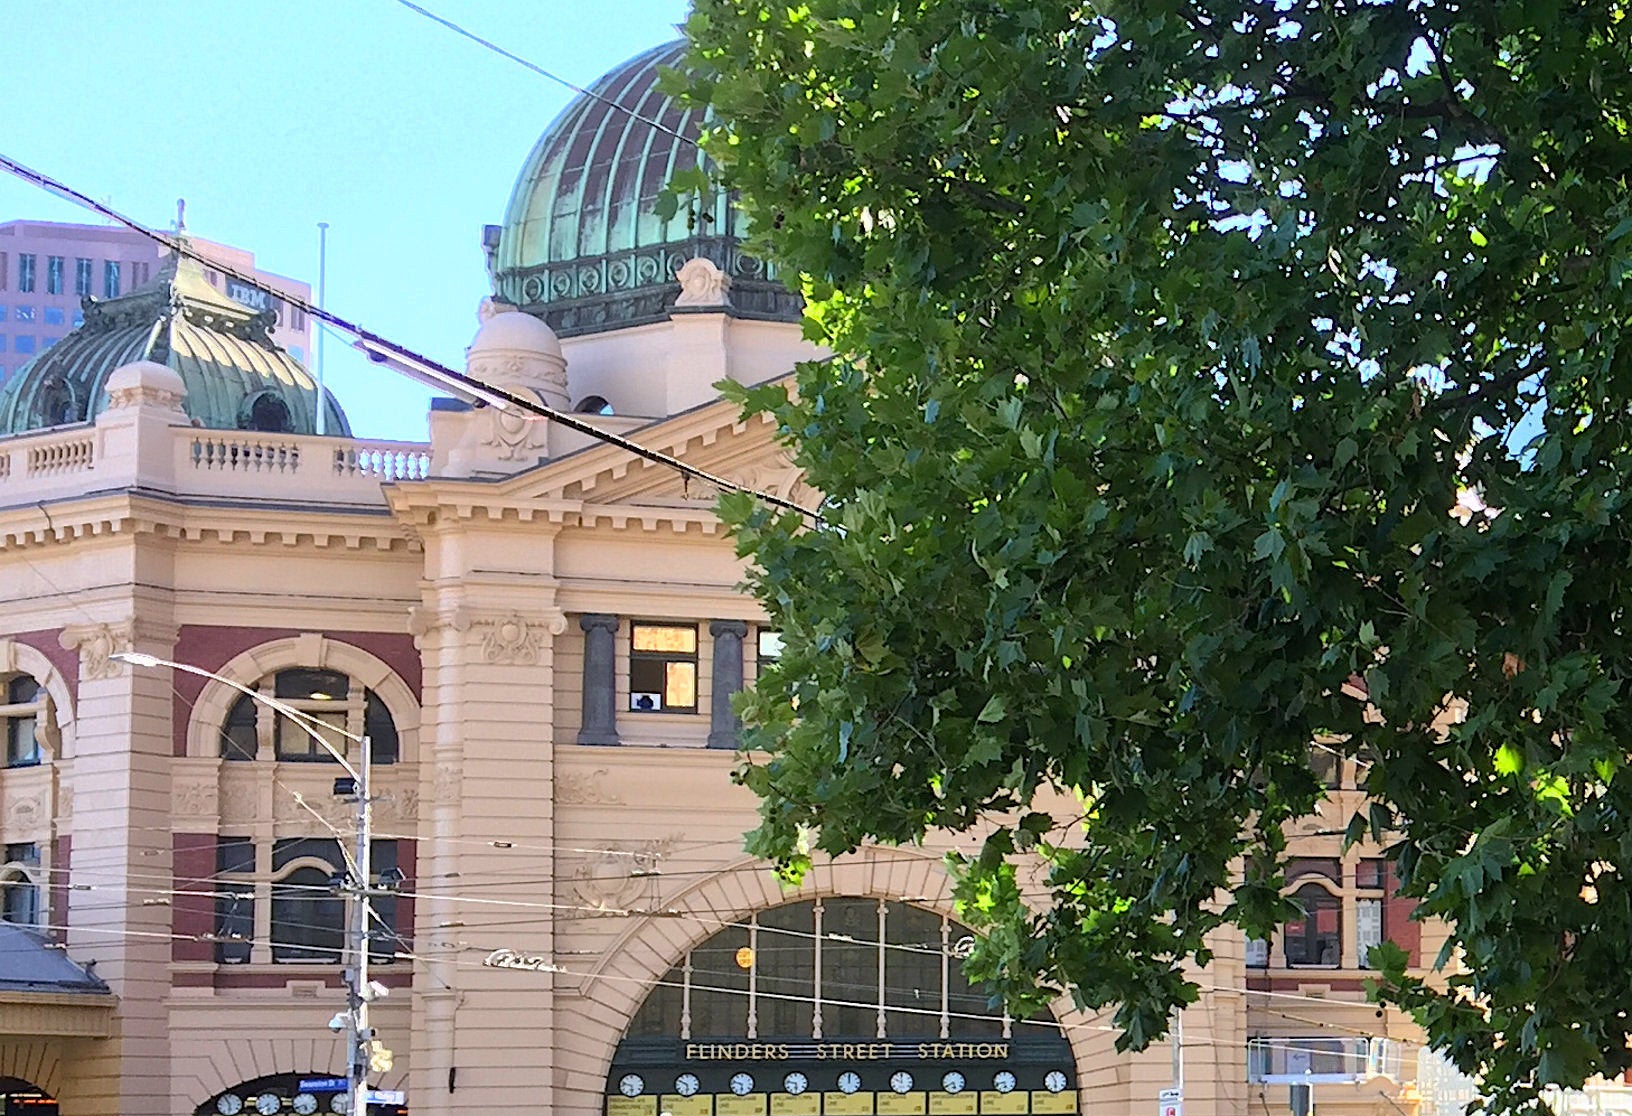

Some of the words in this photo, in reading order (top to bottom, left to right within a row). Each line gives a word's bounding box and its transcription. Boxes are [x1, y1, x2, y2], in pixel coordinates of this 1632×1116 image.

[686, 1044, 789, 1060] FLINDERS
[816, 1043, 894, 1060] STREET
[918, 1043, 1010, 1059] STATION
